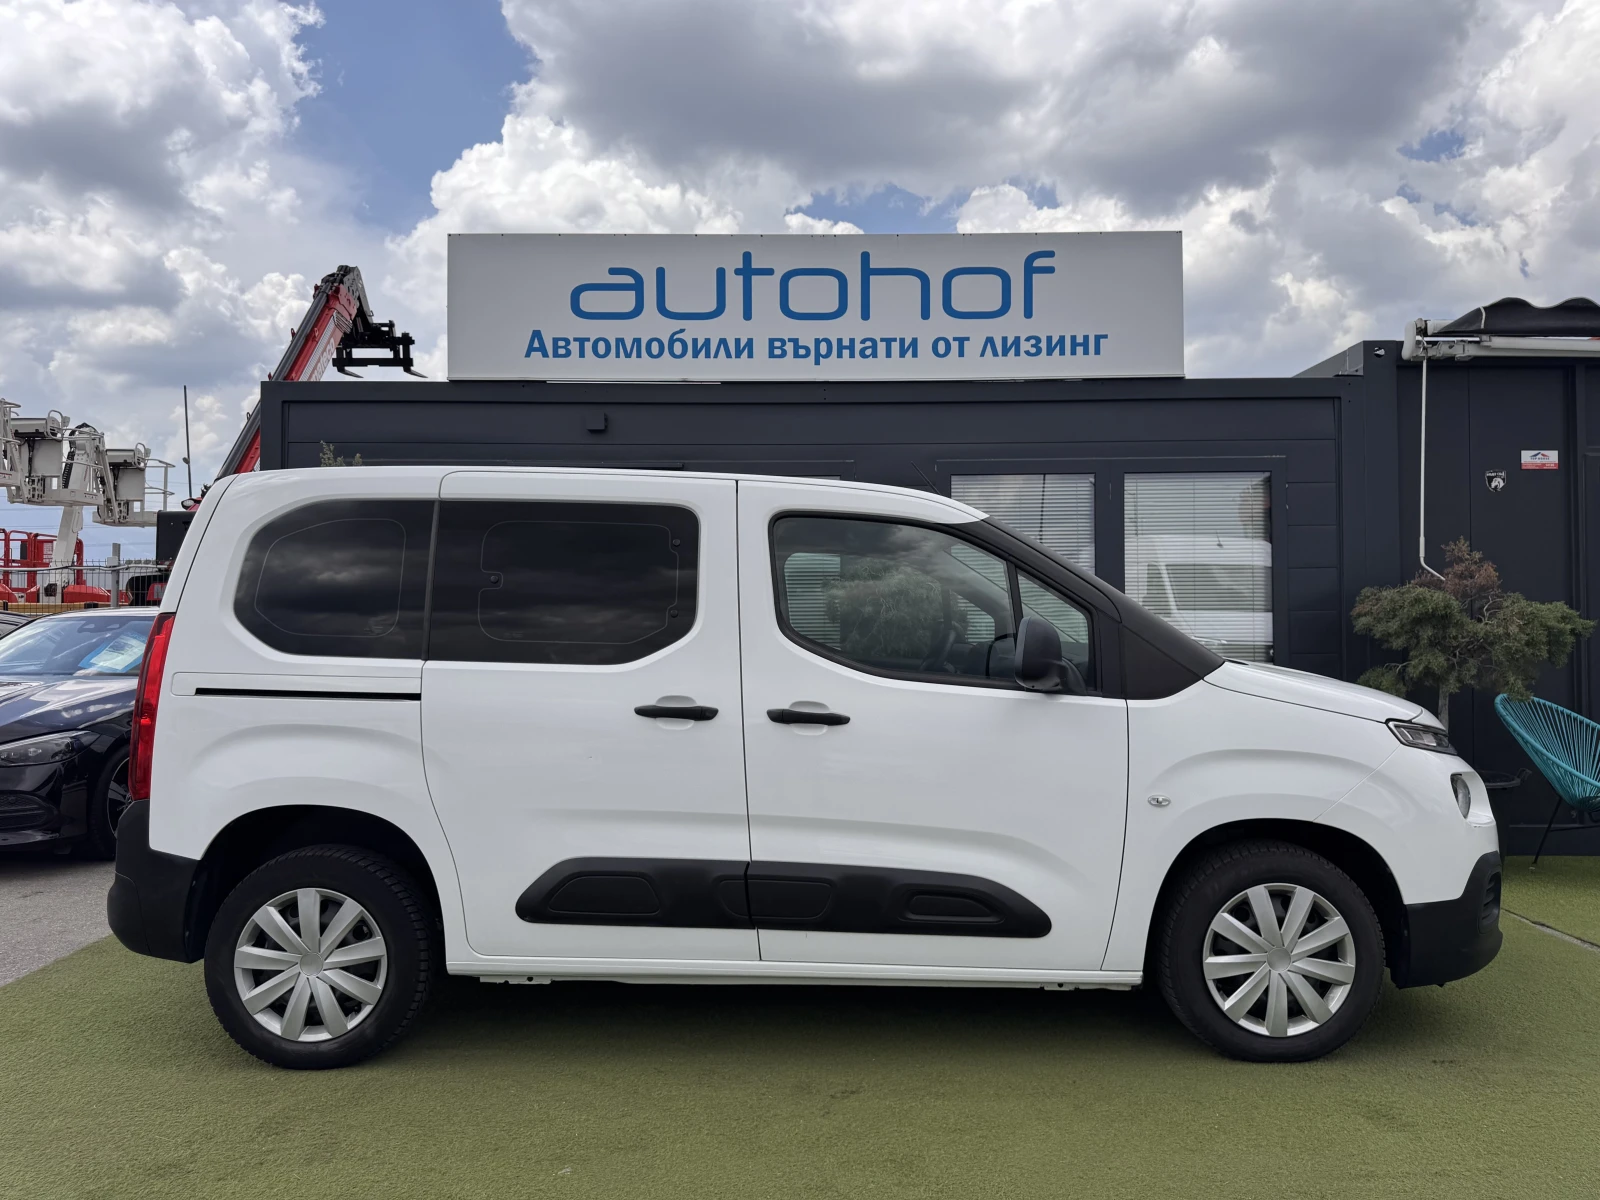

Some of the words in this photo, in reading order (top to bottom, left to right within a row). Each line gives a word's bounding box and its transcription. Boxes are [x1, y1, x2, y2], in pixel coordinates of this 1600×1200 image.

[570, 250, 1056, 322] autohof
[525, 328, 755, 360] Автомобили
[767, 336, 919, 366] върнати
[931, 336, 970, 359] от
[980, 334, 1109, 358] лизинг
